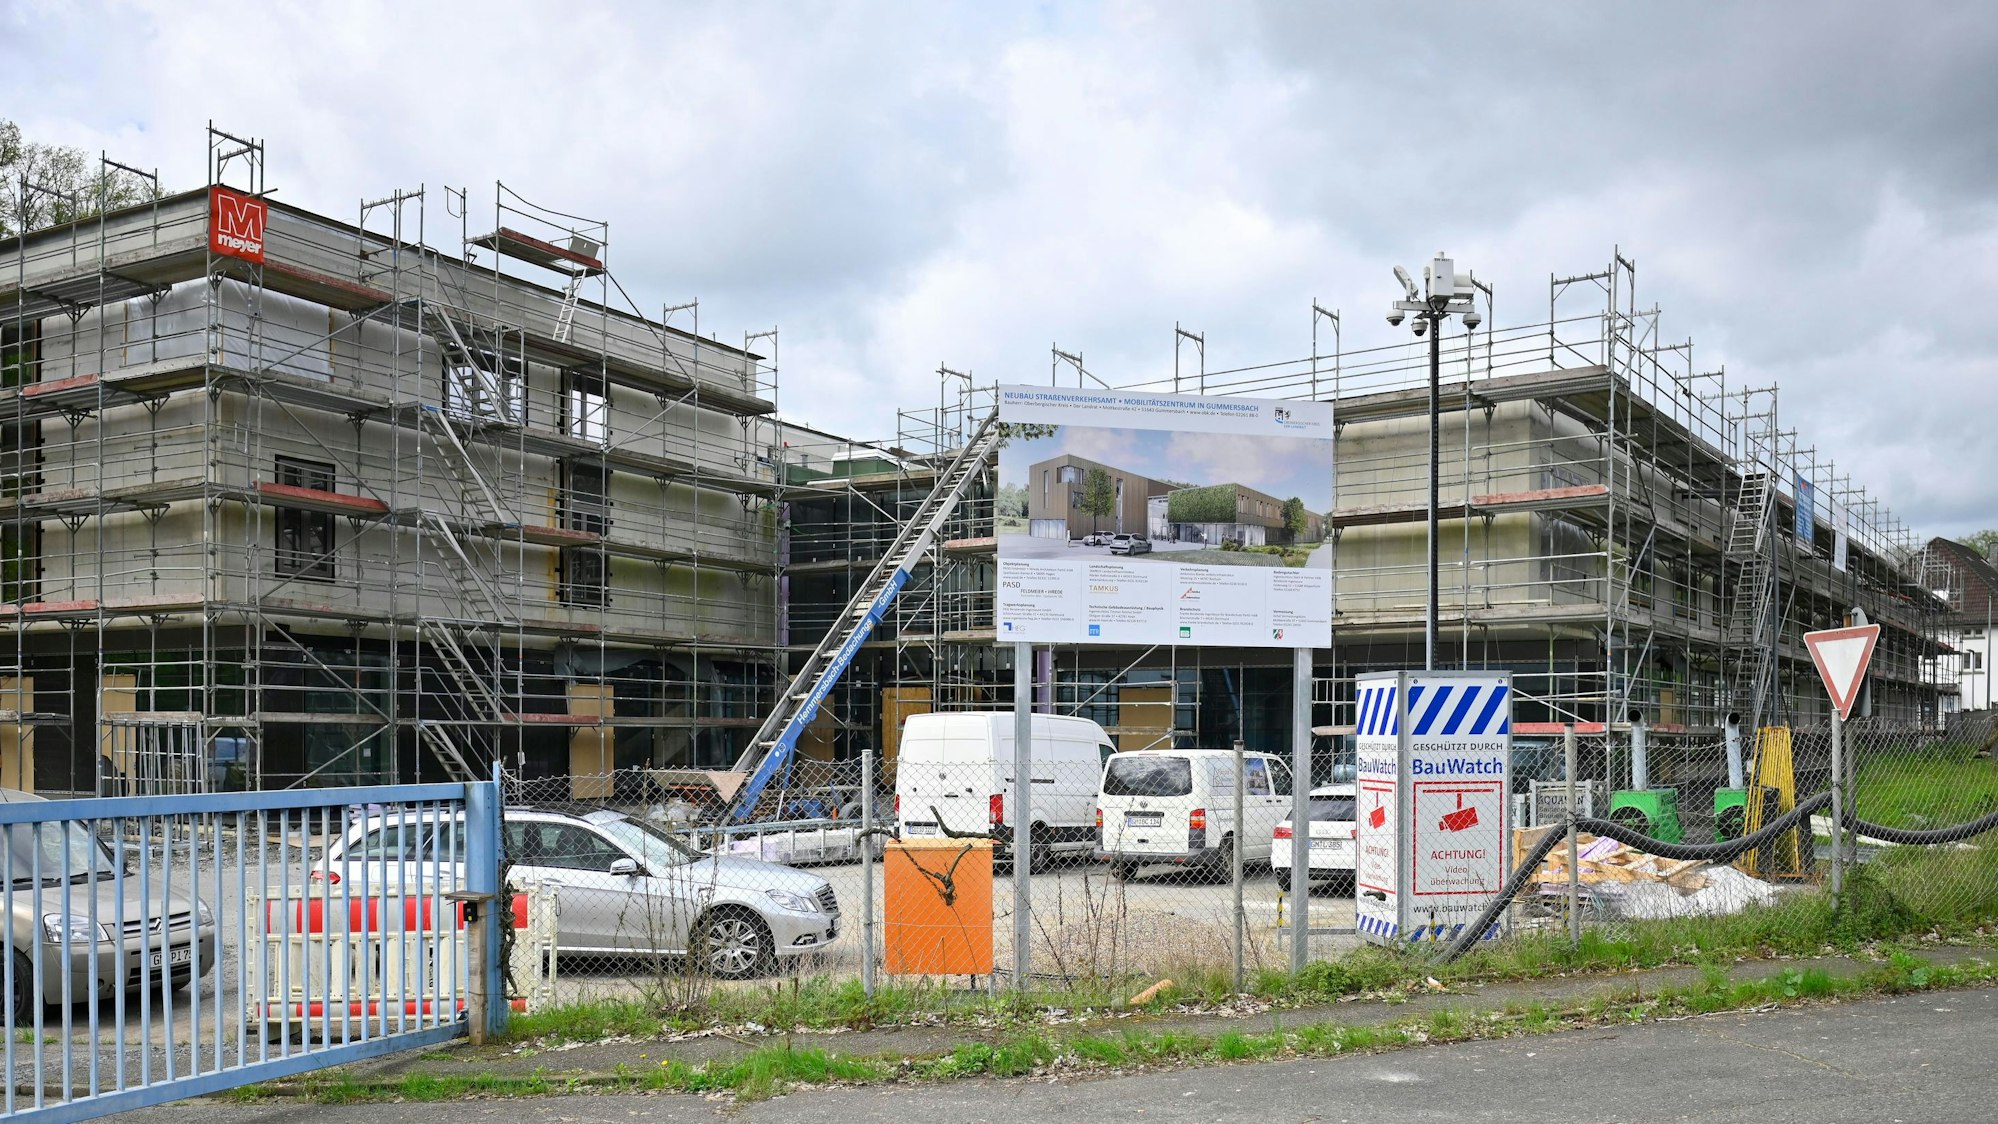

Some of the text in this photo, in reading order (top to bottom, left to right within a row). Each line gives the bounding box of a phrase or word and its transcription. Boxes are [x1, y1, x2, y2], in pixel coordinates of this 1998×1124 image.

[218, 233, 262, 254] meyer
[1004, 392, 1034, 400] NEUBAU
[1035, 393, 1117, 405] STRAßENVERKEHRSAMT
[1123, 397, 1196, 409] MOBILITÄTSZENTRUM
[1206, 403, 1259, 412] GUMMERSBACH
[1002, 581, 1021, 589] PASD
[1413, 741, 1503, 751] GESCHÜTZT DURCH
[1359, 756, 1397, 775] BauWatch
[1412, 757, 1503, 775] BauWatch
[1430, 848, 1486, 860] ACHTUNG!
[1430, 877, 1485, 887] überwachung
